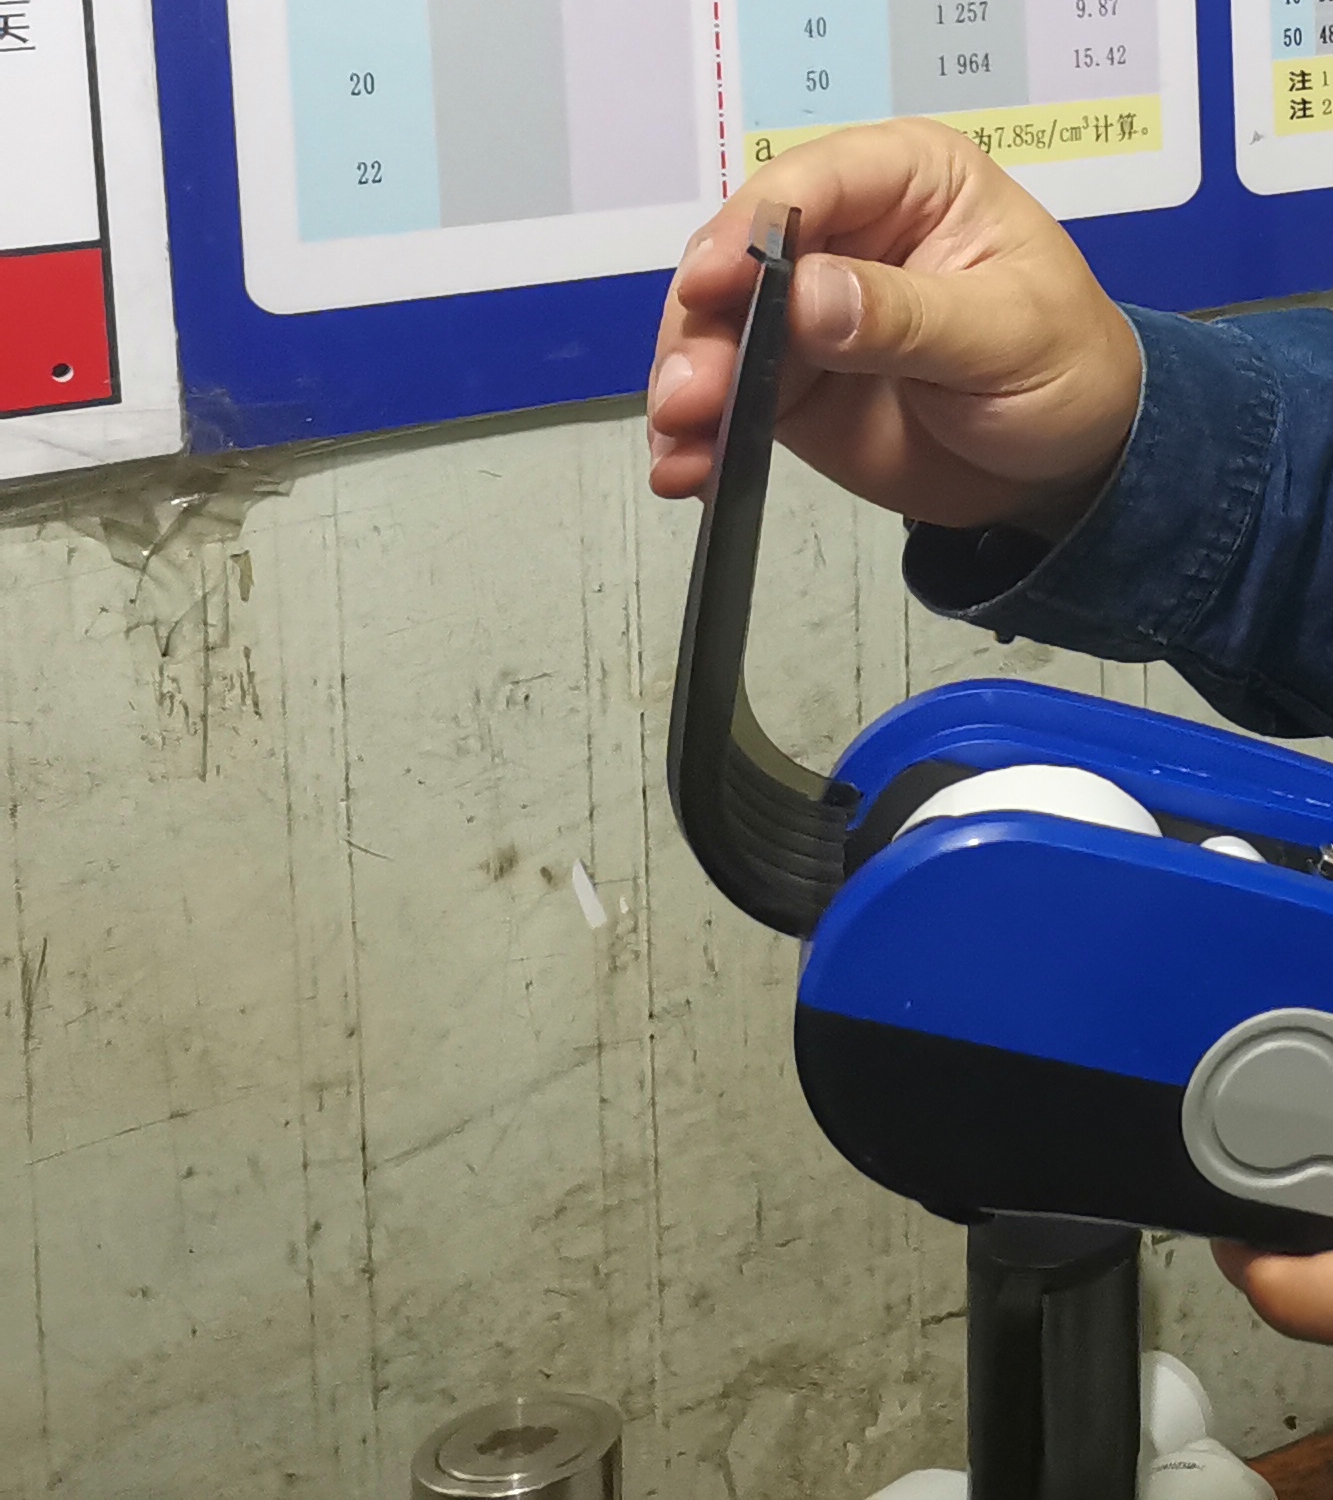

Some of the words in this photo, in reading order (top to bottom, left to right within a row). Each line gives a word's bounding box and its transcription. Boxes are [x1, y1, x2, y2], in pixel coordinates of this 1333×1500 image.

[803, 16, 827, 39] 40
[1282, 26, 1303, 48] 50
[1073, 44, 1127, 69] 15.42
[349, 71, 375, 97] 20
[805, 69, 830, 92] 50
[1288, 69, 1314, 93] 注
[1288, 96, 1315, 121] 注
[356, 159, 383, 186] 22
